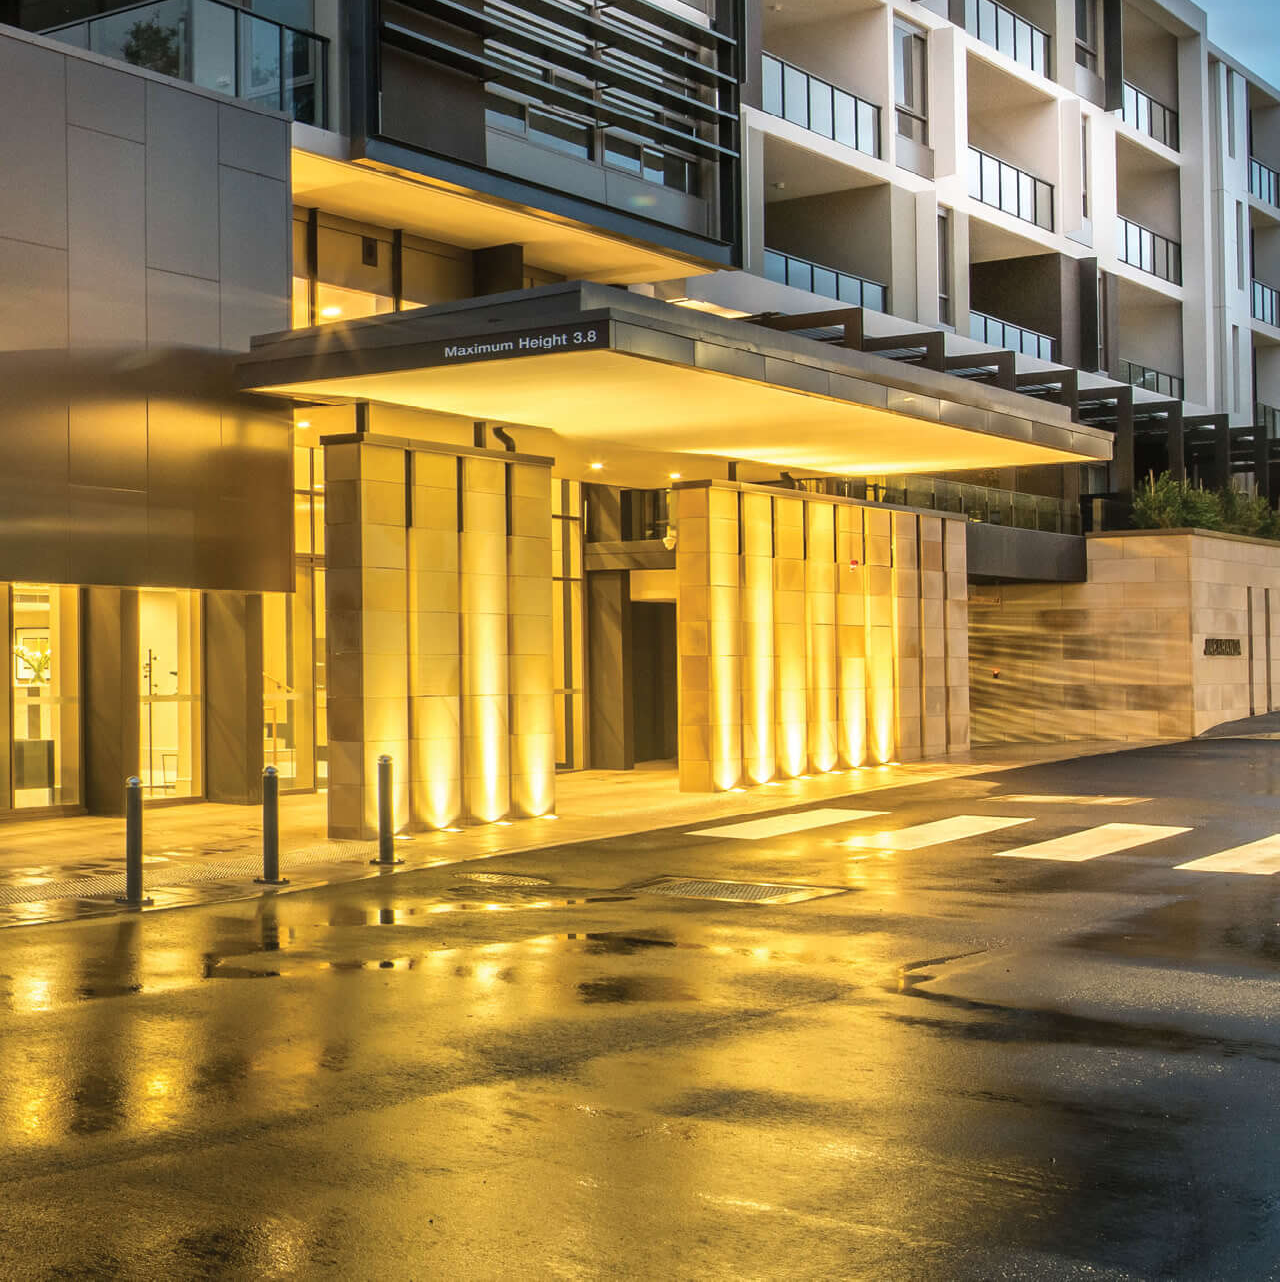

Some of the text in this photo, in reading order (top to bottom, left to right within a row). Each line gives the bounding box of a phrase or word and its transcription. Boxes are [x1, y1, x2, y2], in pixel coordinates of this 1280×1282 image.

[444, 329, 597, 358] Maximum Height 3.8
